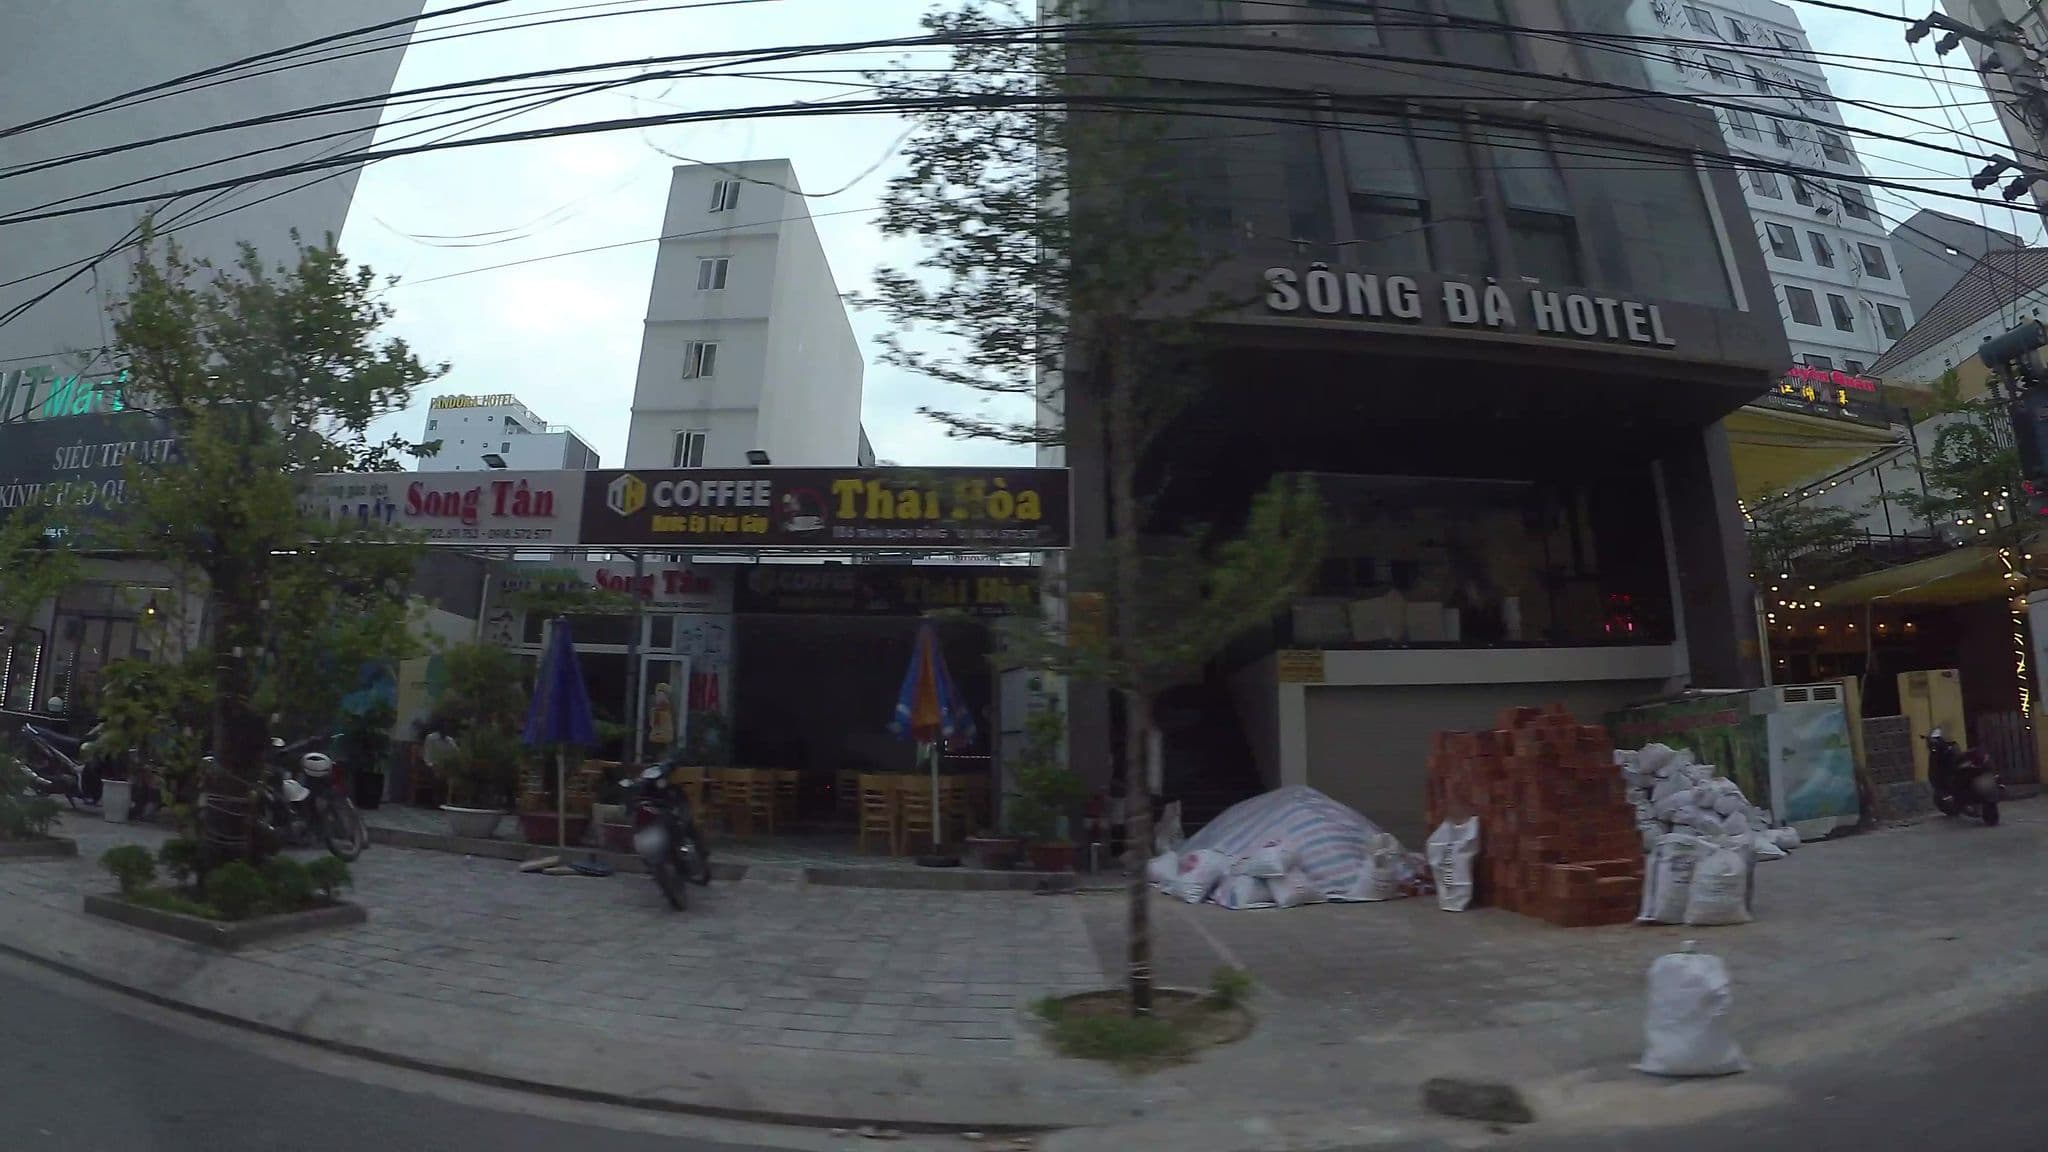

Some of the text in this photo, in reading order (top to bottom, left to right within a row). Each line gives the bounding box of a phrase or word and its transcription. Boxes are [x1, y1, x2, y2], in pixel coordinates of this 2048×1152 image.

[1264, 261, 1676, 346] SÔNG ĐÀ HOTEL
[482, 394, 514, 407] HOTEL
[405, 478, 557, 526] Song Tân
[652, 480, 772, 508] COFFEE
